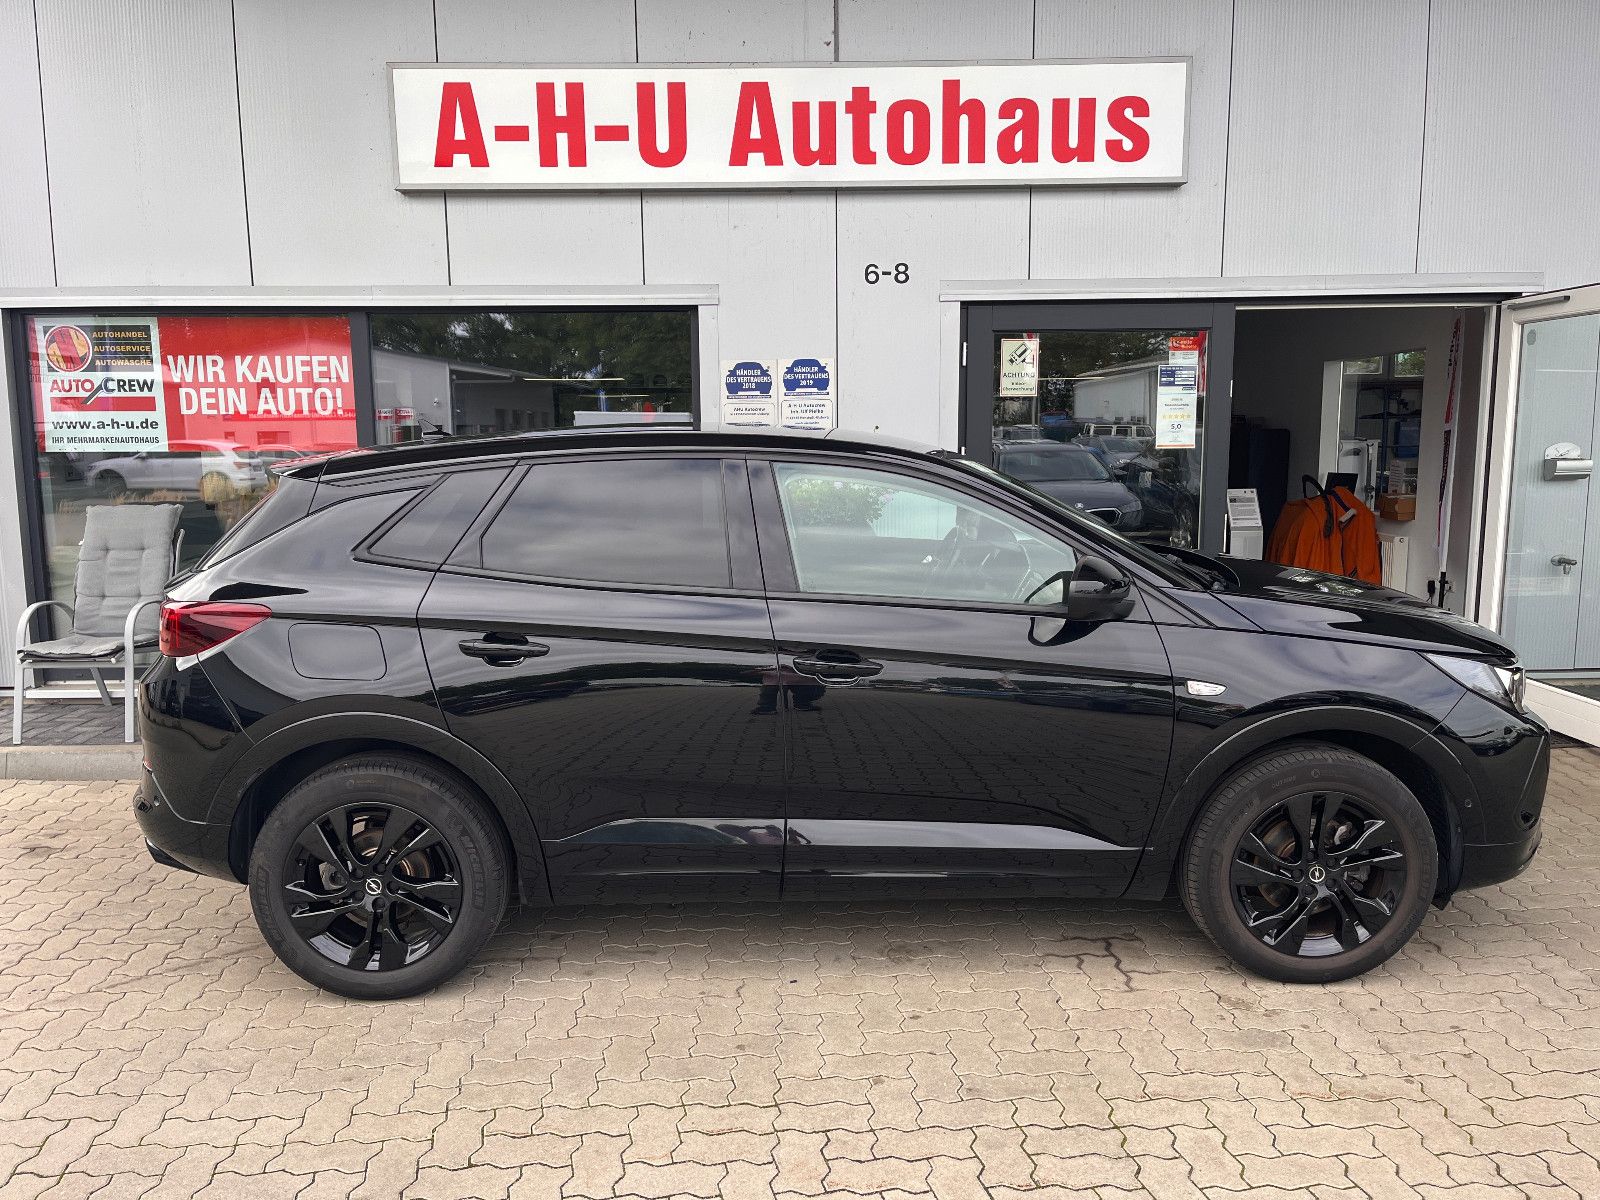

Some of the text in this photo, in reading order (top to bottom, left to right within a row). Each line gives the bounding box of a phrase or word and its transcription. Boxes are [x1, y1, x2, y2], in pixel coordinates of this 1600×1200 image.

[434, 79, 1150, 168] A-H-U Autohaus
[864, 263, 910, 285] 6-8
[167, 355, 350, 383] WIR KAUFEN
[736, 368, 761, 376] HÄNDLER
[50, 377, 155, 394] AUTO CREW
[179, 387, 343, 416] DEIN AUTO!
[52, 418, 159, 430] www.a-h-u.de
[1170, 423, 1182, 431] 5,0
[52, 436, 160, 444] IHR MEHRMARKENAUTOHAUS
